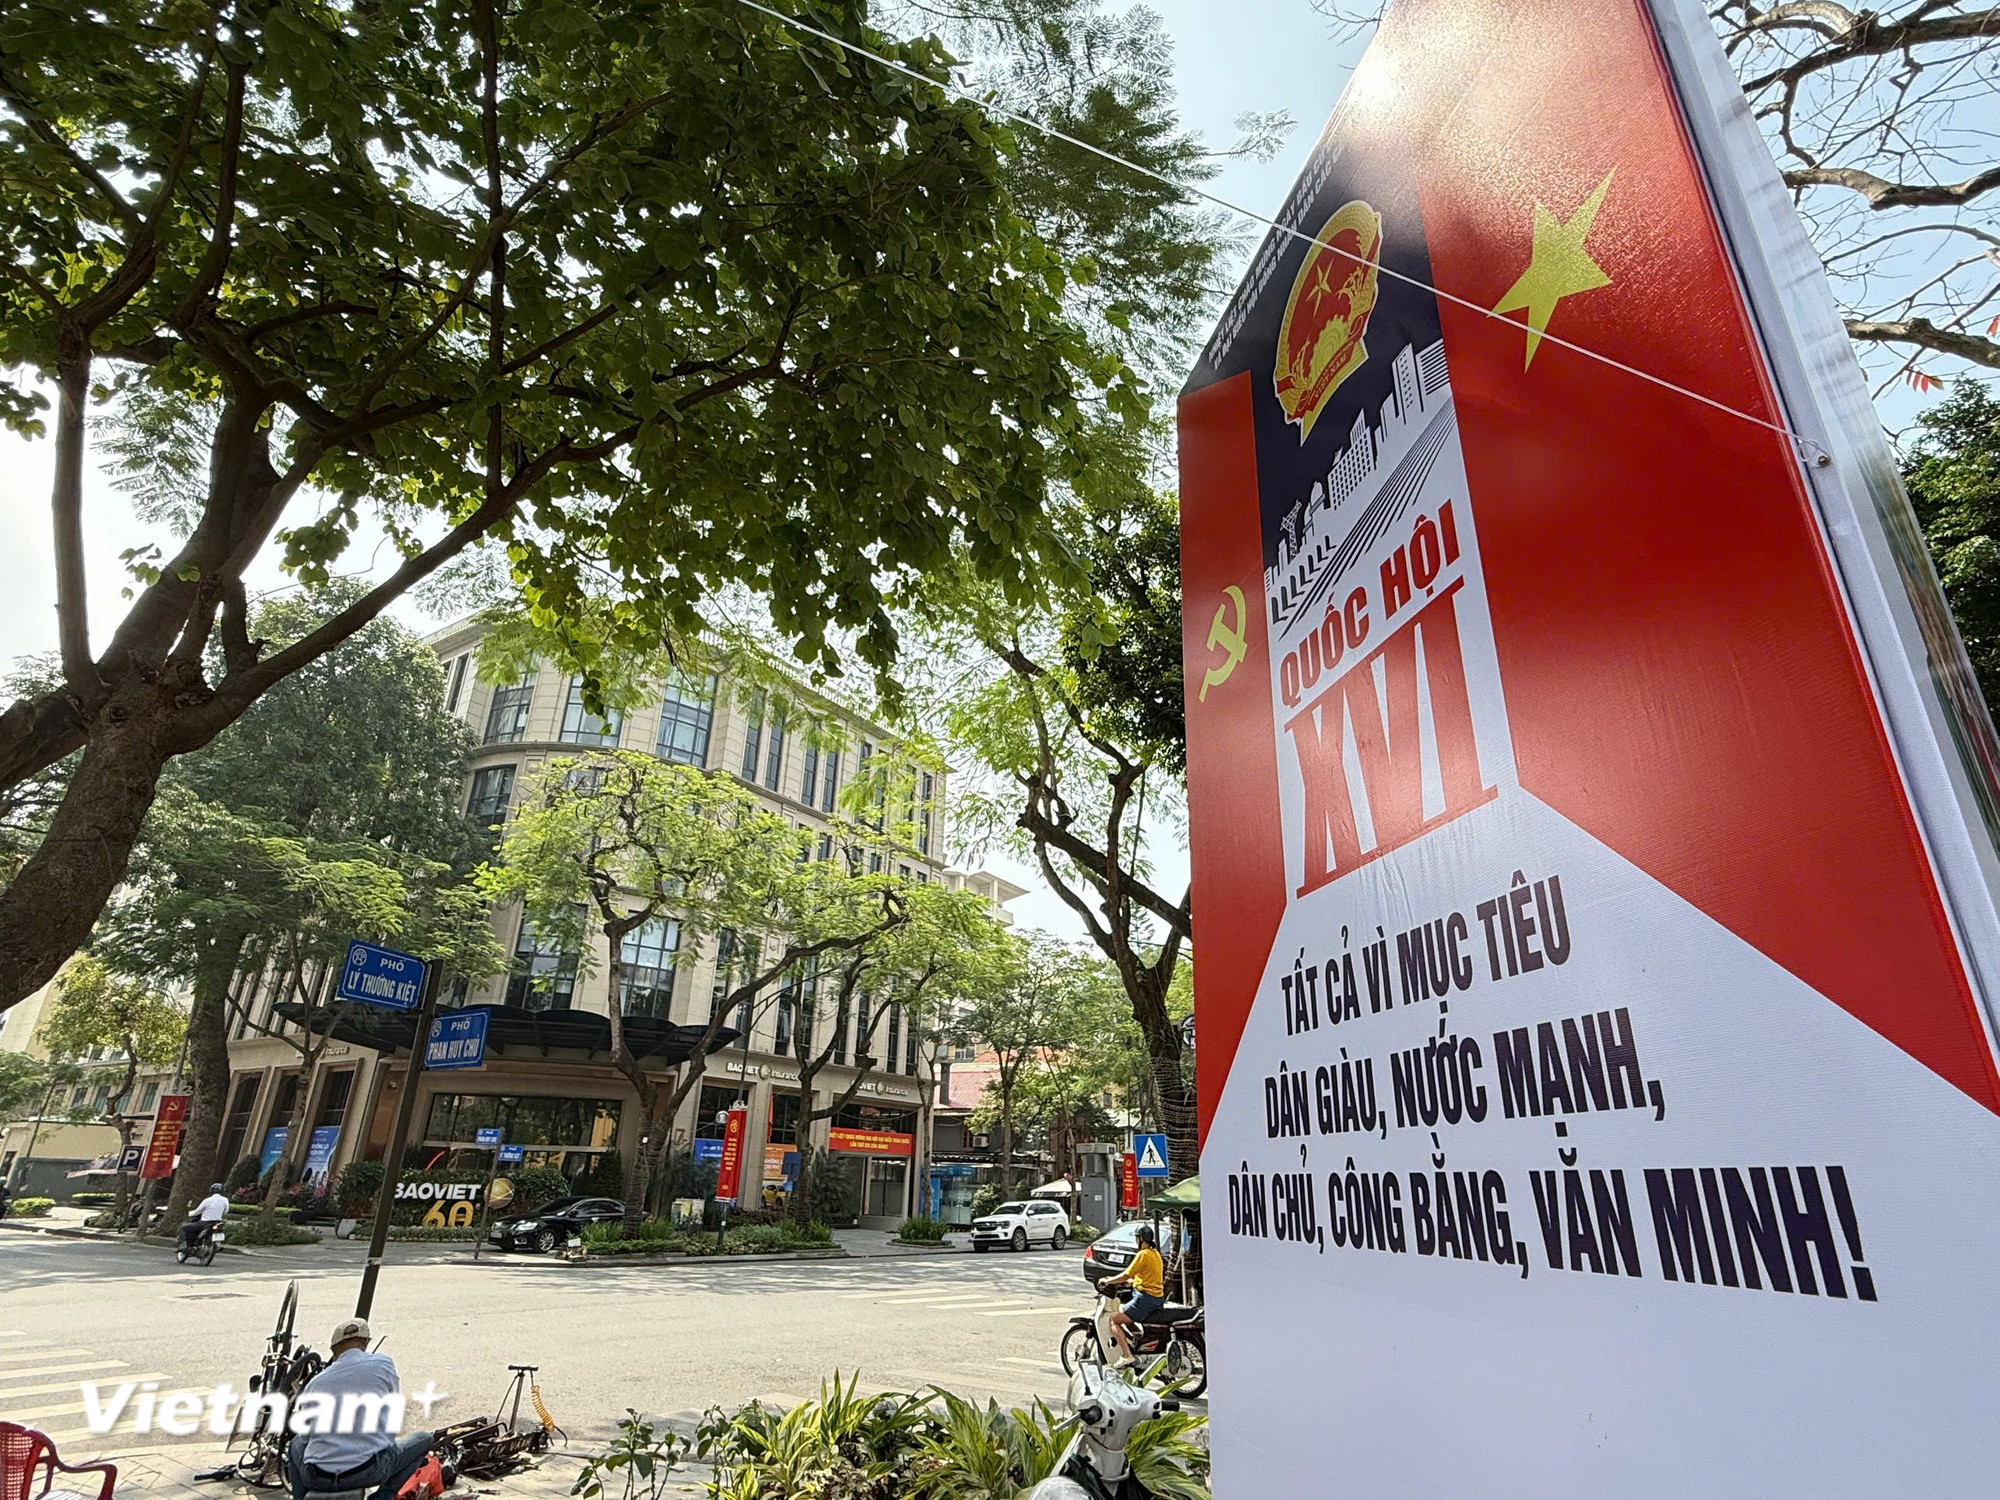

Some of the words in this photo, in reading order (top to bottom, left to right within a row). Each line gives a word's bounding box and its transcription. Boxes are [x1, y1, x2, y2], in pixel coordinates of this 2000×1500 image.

[1280, 586, 1370, 708] QUỐC
[1379, 498, 1460, 620] HỘI
[1284, 574, 1499, 900] XVI
[380, 958, 407, 972] PHỐ
[1281, 947, 1319, 1036] TẤT
[1325, 925, 1361, 1025] CẢ
[1362, 925, 1393, 1014] VÌ
[1396, 912, 1473, 1013] MỤC
[1476, 870, 1571, 981] TIÊU
[347, 967, 361, 990] LÝ
[361, 972, 396, 998] THƯỜNG
[395, 980, 417, 1005] KIỆT
[451, 1017, 472, 1031] PHỐ
[428, 1041, 449, 1060] PHAN
[448, 1040, 465, 1059] HUY
[727, 1062, 759, 1075] BAOIET
[1265, 1060, 1311, 1139] DÂN
[1315, 1047, 1388, 1140] GIÀU,
[1390, 1018, 1487, 1128] NƯỚC
[1493, 1007, 1665, 1137] MẠNH,
[122, 1149, 139, 1166] P
[1228, 1160, 1268, 1238] DÂN
[1272, 1143, 1324, 1254] CHỦ,
[1328, 1157, 1407, 1253] CÔNG
[1409, 1132, 1529, 1279] BẰNG,
[1528, 1147, 1642, 1278] VĂN
[1643, 1165, 1878, 1302] MINH!
